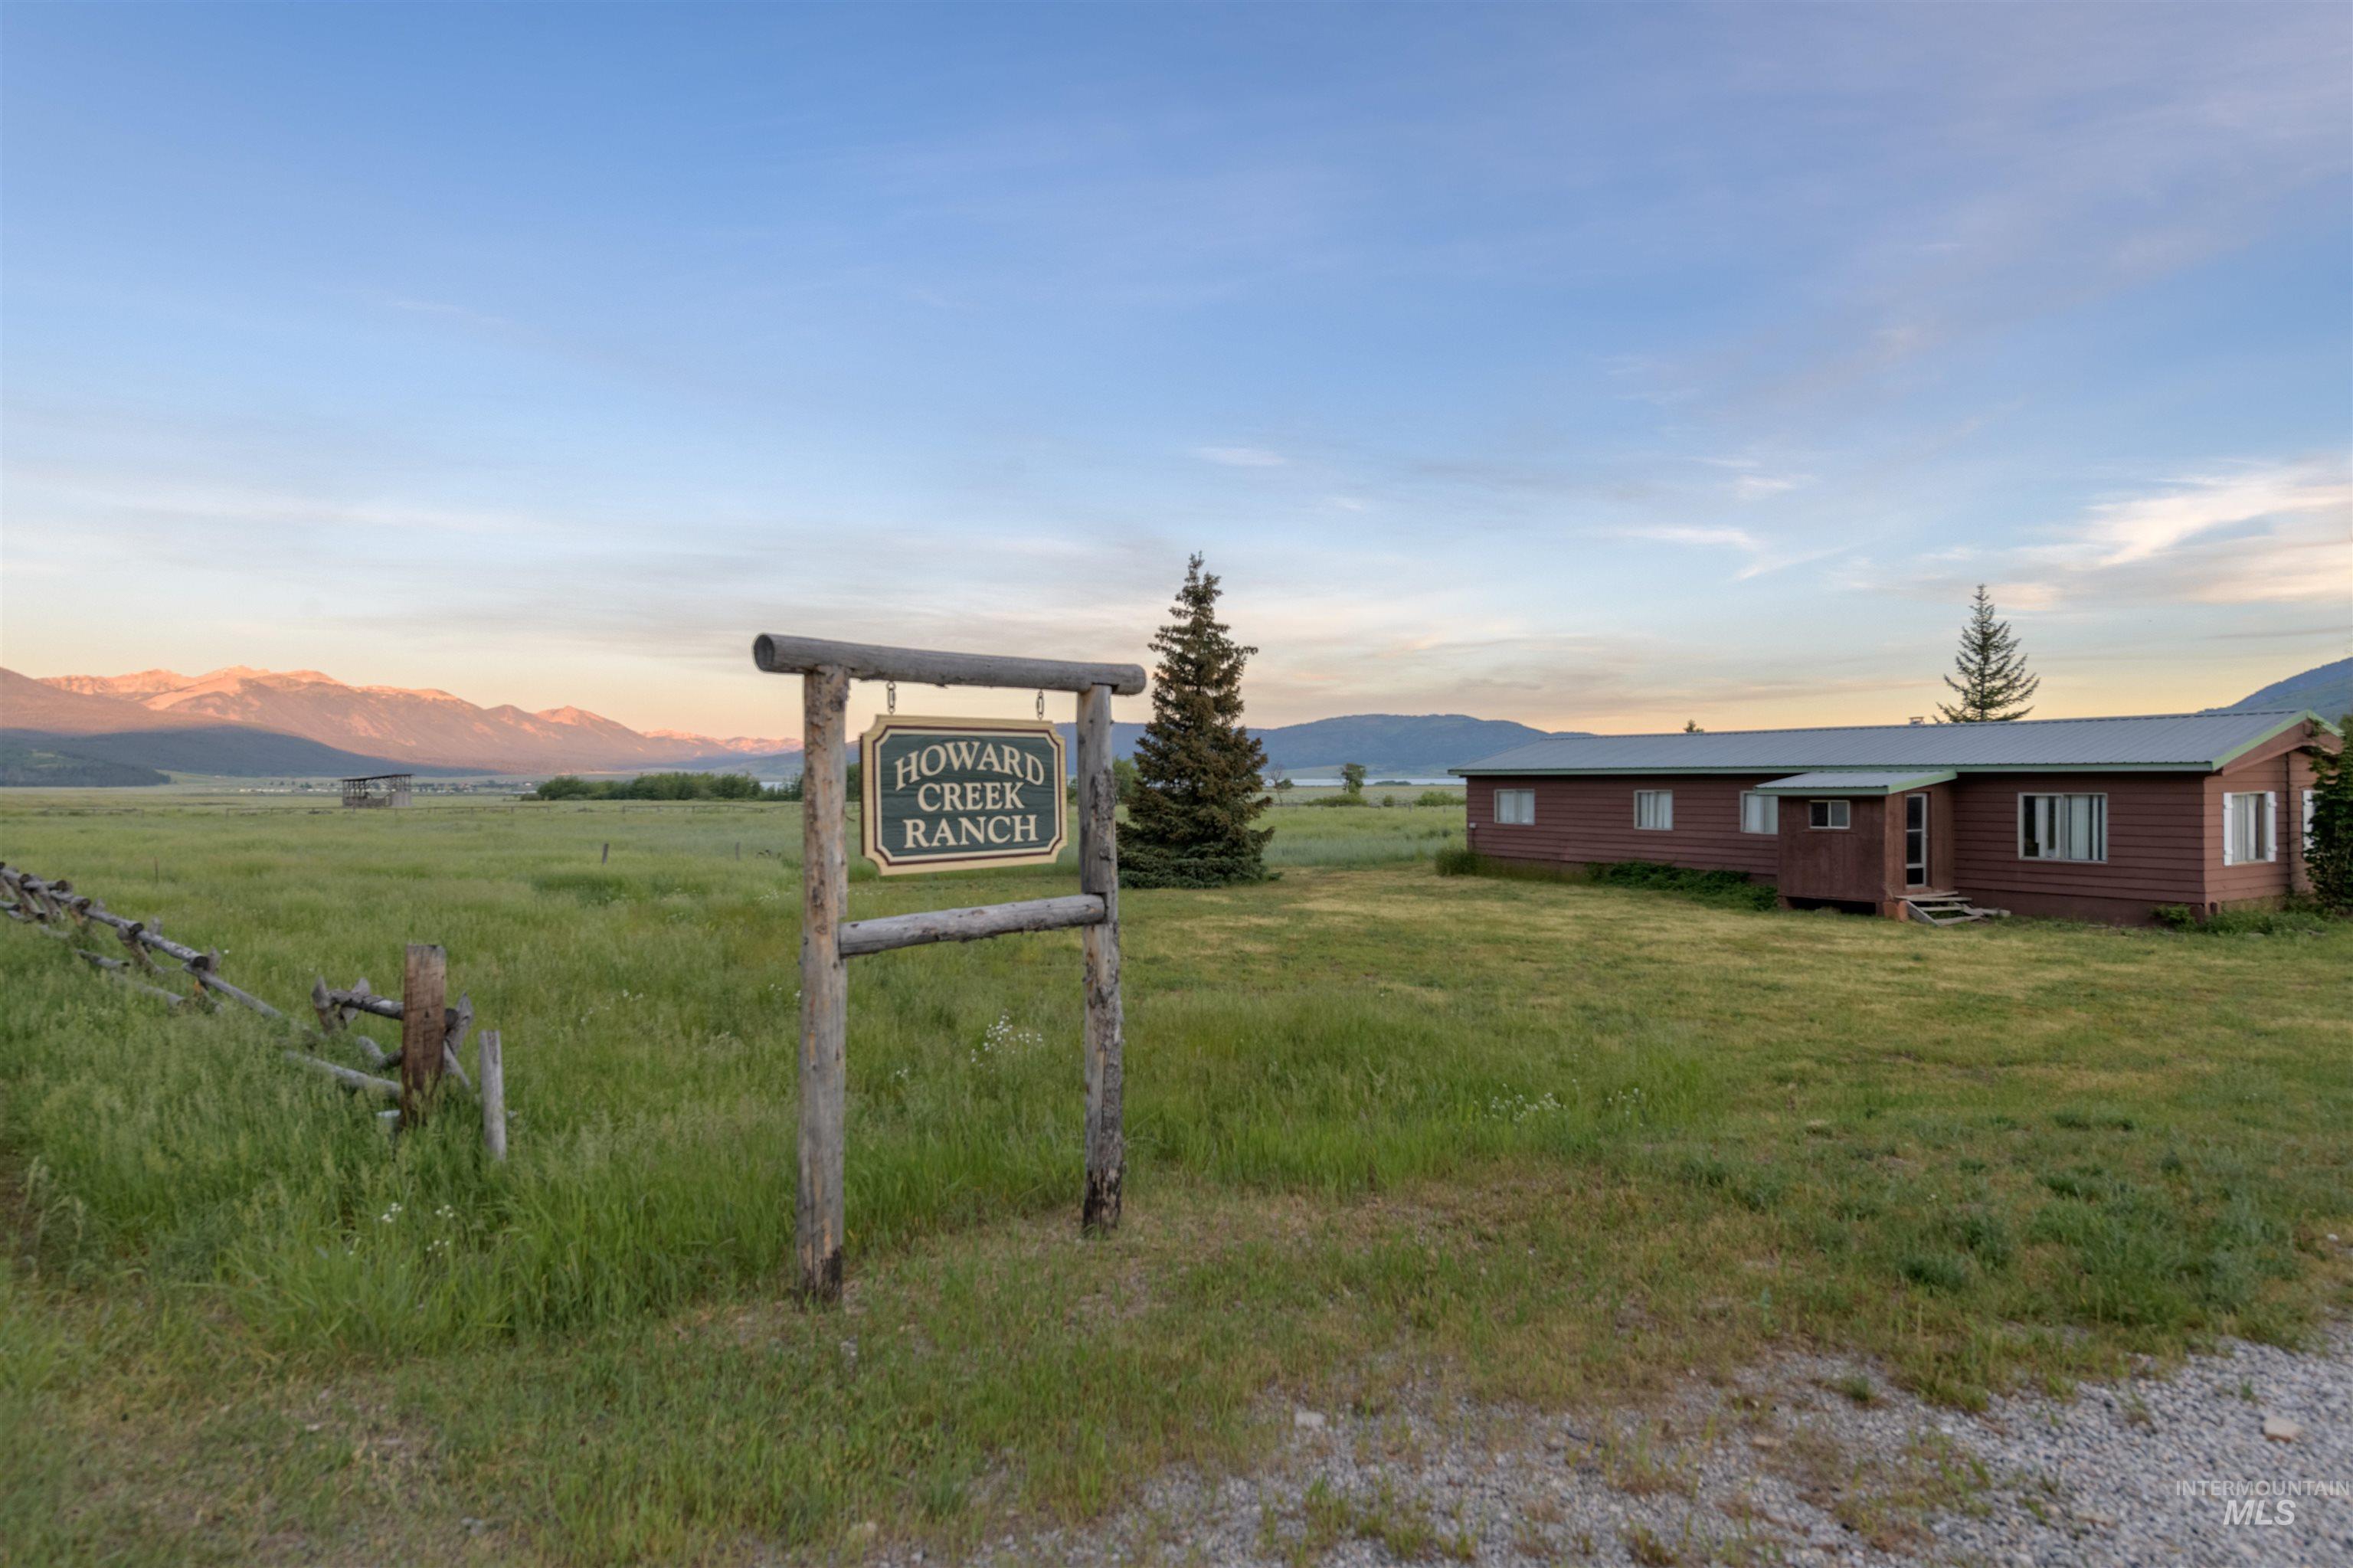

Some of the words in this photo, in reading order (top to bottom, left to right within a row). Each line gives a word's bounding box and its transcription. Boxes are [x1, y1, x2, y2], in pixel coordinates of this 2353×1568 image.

[895, 741, 1044, 791] HOWARD
[918, 781, 1025, 812] CREEK
[903, 814, 1039, 849] RANCH
